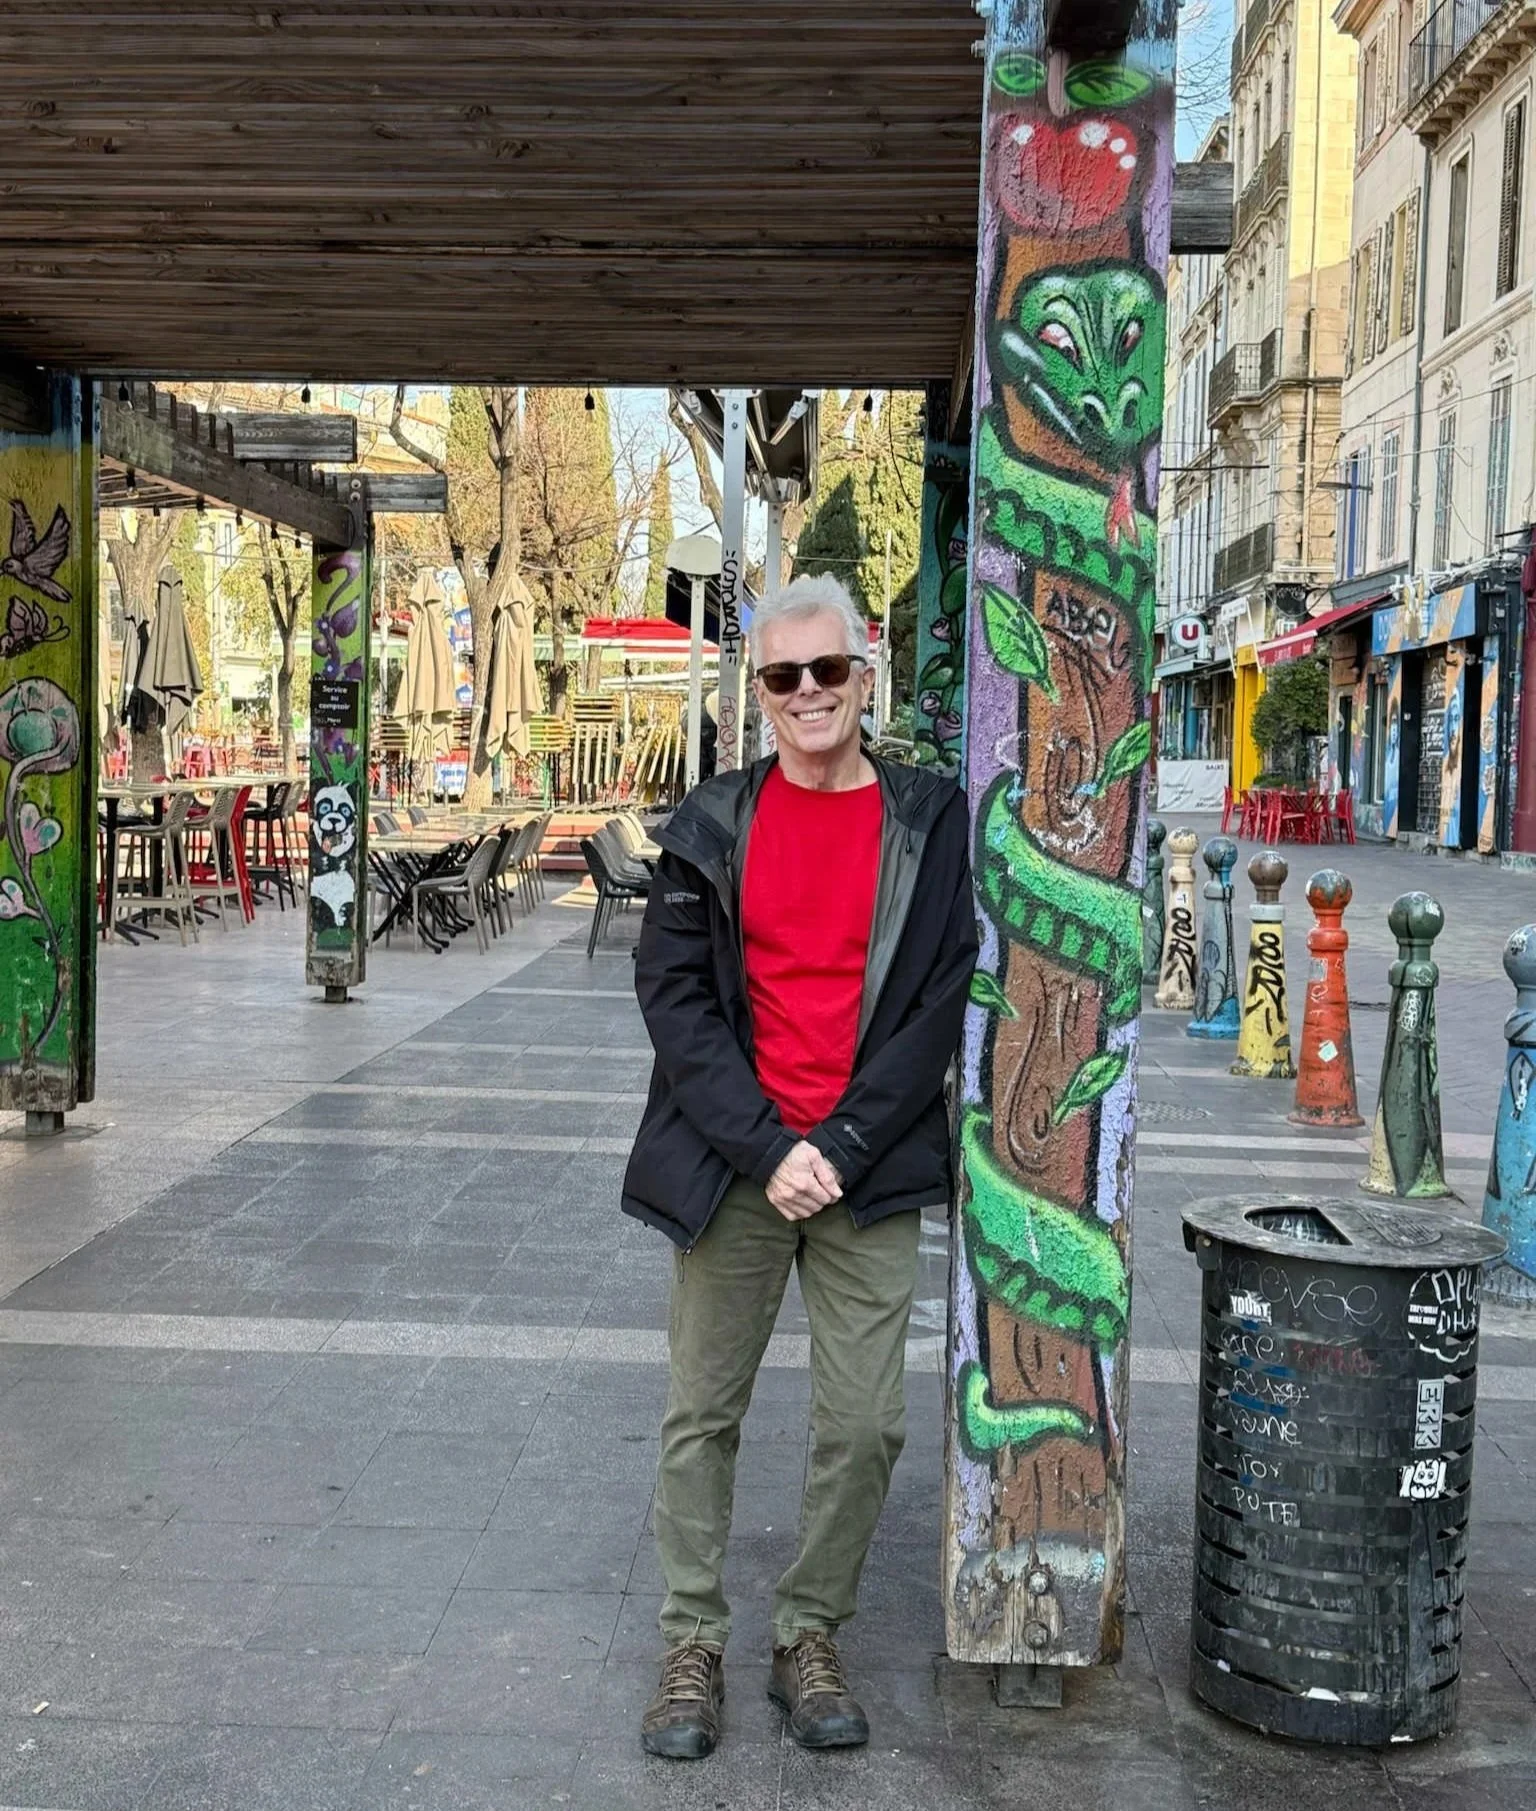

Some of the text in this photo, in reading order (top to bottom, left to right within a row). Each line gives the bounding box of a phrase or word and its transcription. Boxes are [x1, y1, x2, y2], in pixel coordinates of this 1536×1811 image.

[1181, 624, 1199, 641] U
[322, 684, 348, 694] Service
[318, 703, 351, 711] comptoir
[1416, 1382, 1441, 1447] ERK
